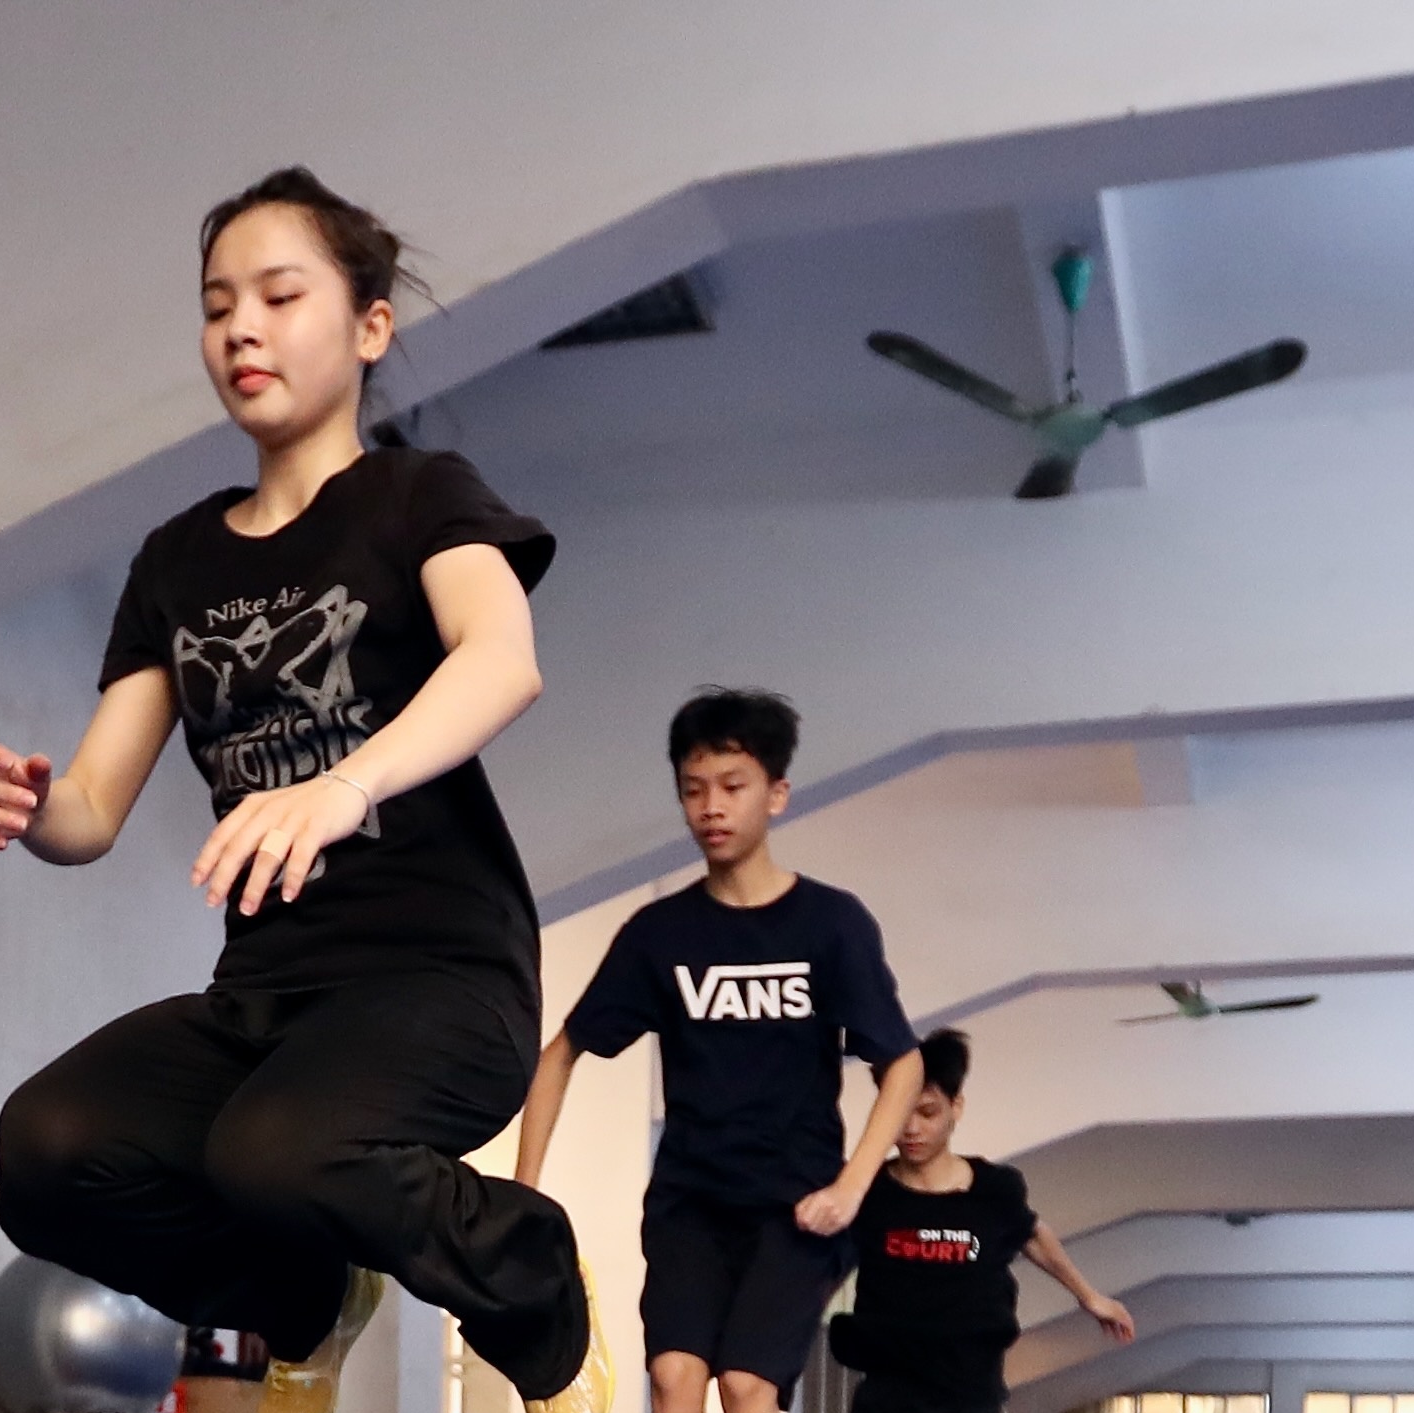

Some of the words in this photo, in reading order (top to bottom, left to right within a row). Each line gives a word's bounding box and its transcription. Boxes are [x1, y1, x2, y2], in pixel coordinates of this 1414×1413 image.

[206, 597, 268, 627] Nike
[272, 586, 306, 609] Air
[674, 962, 813, 1020] VANS
[918, 1229, 941, 1241] ON
[943, 1229, 971, 1242] THE
